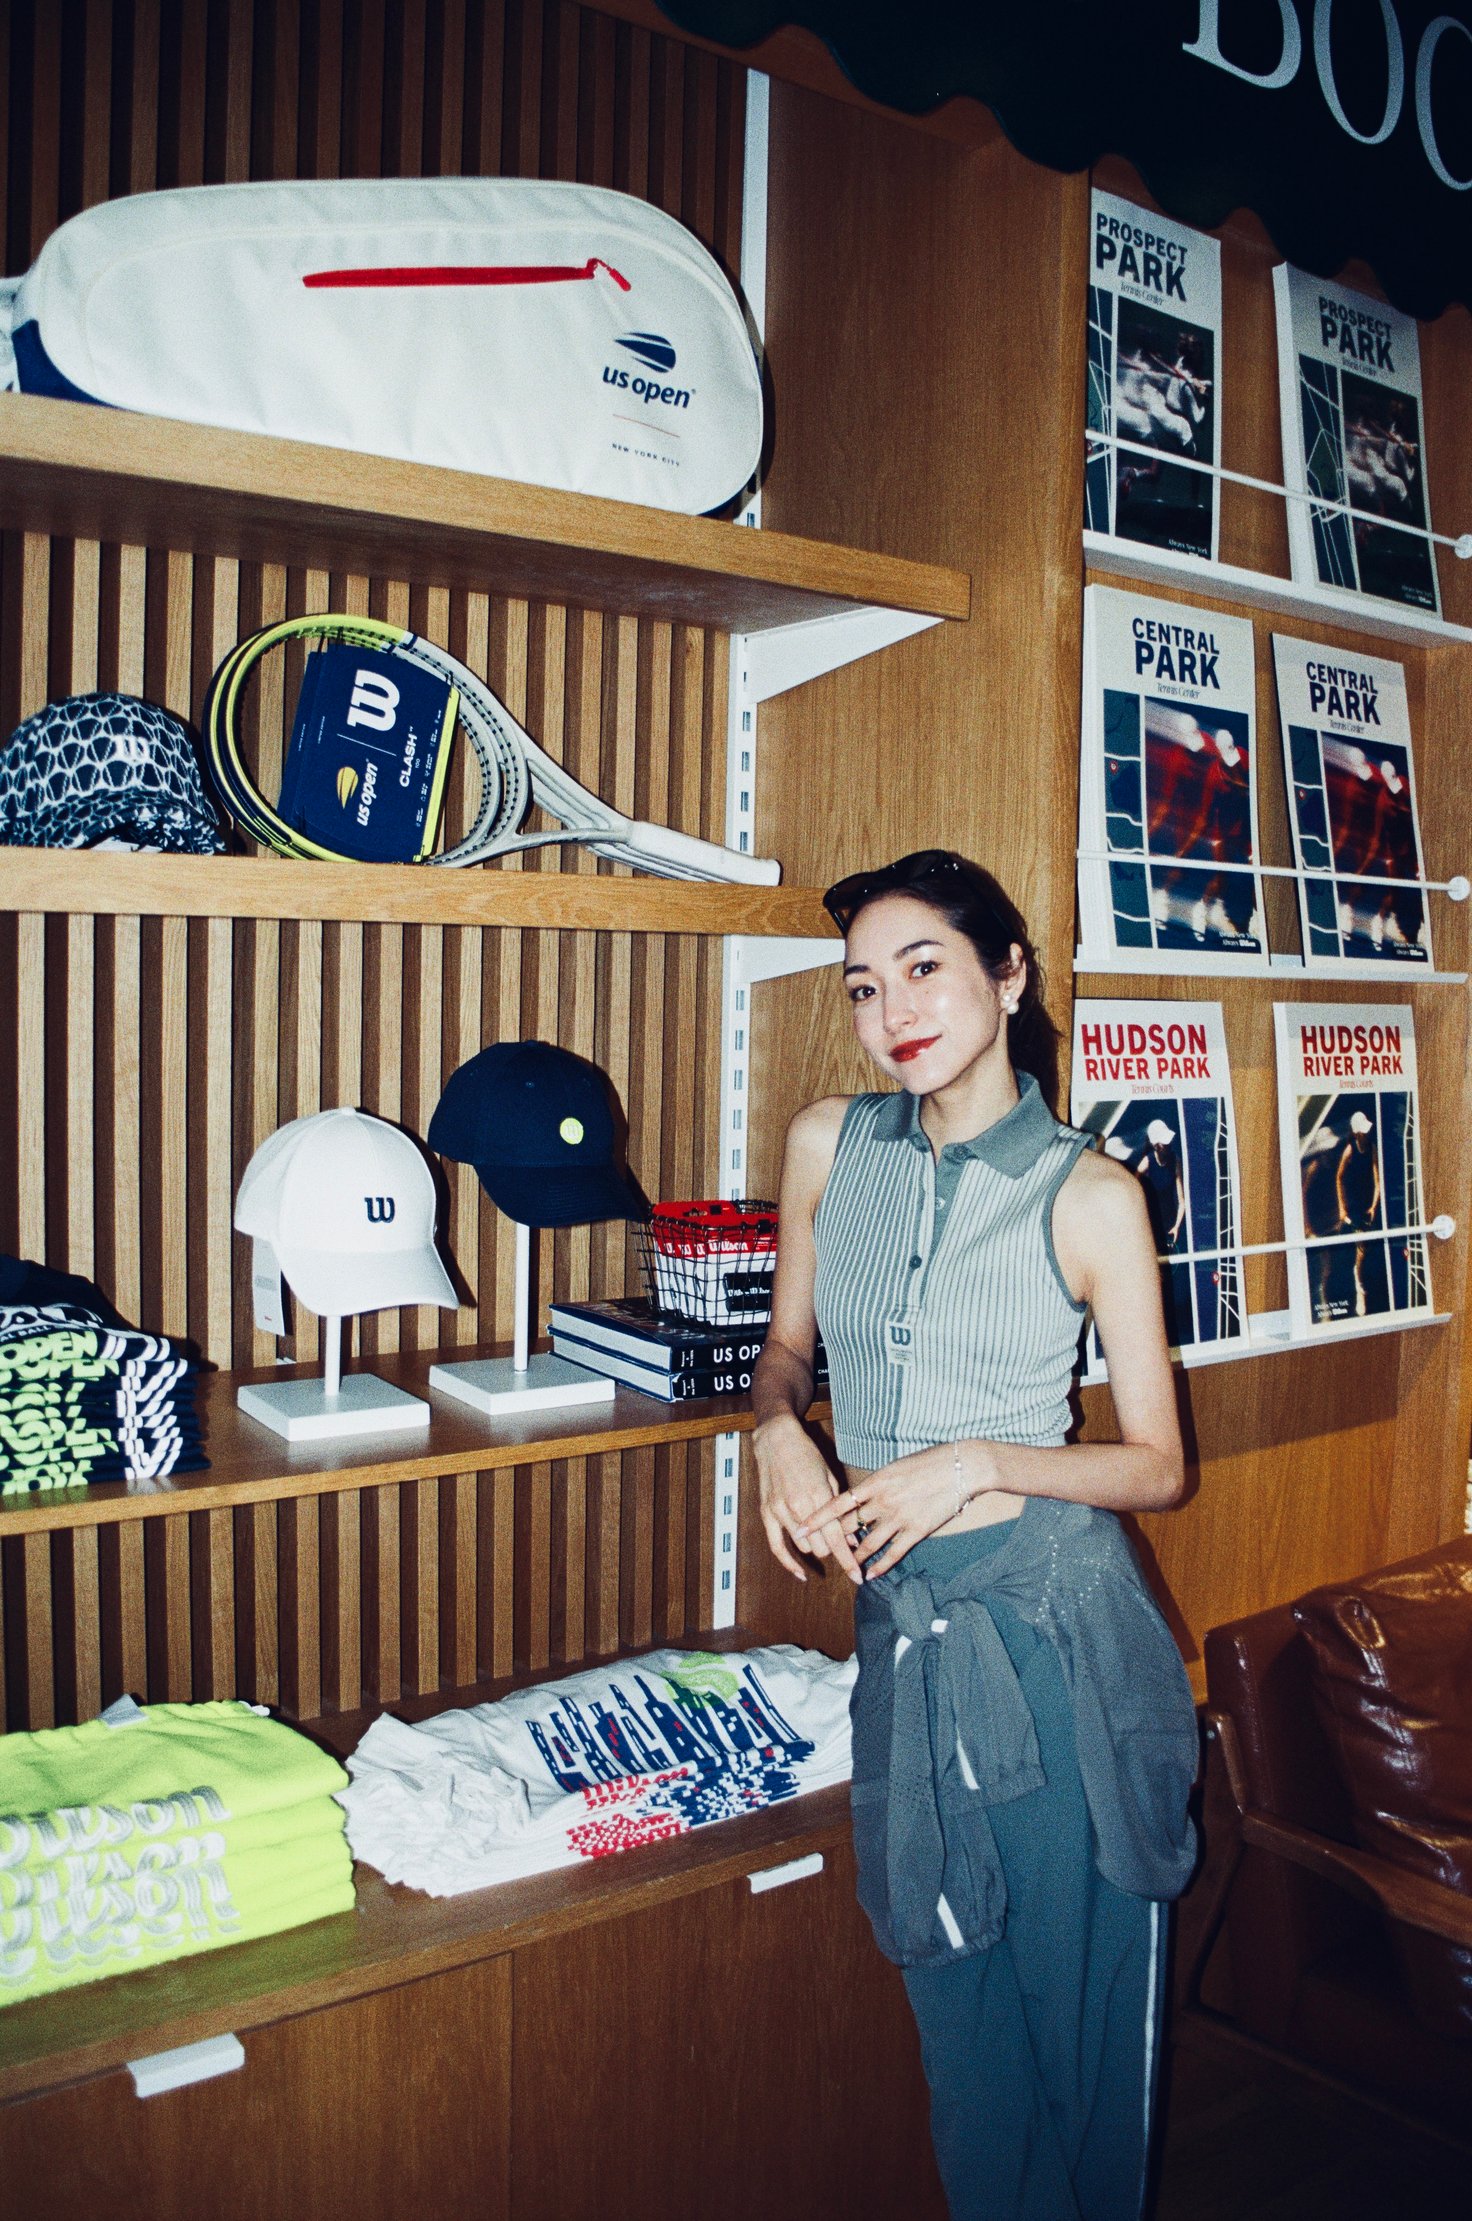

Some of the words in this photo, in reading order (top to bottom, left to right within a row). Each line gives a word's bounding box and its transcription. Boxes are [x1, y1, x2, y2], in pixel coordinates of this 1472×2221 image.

[1096, 212, 1188, 265] PROSPECT
[1096, 232, 1187, 302] PARK
[1318, 295, 1392, 339] PROSPECT
[1320, 314, 1395, 373] PARK
[602, 366, 630, 389] us
[632, 377, 691, 408] open
[612, 442, 629, 452] NEW
[634, 449, 658, 460] YORK
[662, 456, 680, 467] CITY
[1132, 617, 1220, 655] CENTRAL
[1135, 640, 1221, 690] PARK
[1306, 661, 1379, 694] CENTRAL
[1309, 681, 1381, 725] PARK
[399, 733, 418, 788] CLASH
[361, 762, 378, 806] open
[357, 803, 370, 826] us
[1081, 1023, 1208, 1056] HUDSON
[1300, 1025, 1402, 1055] HUDSON
[1085, 1057, 1150, 1081] RIVER
[1156, 1057, 1211, 1079] PARK
[1303, 1056, 1354, 1077] RIVER
[1360, 1055, 1403, 1076] PARK
[0, 1331, 98, 1370] OPEN
[714, 1347, 733, 1363] US
[739, 1344, 763, 1360] OP
[714, 1375, 734, 1391] US
[0, 1785, 231, 1867] ilson
